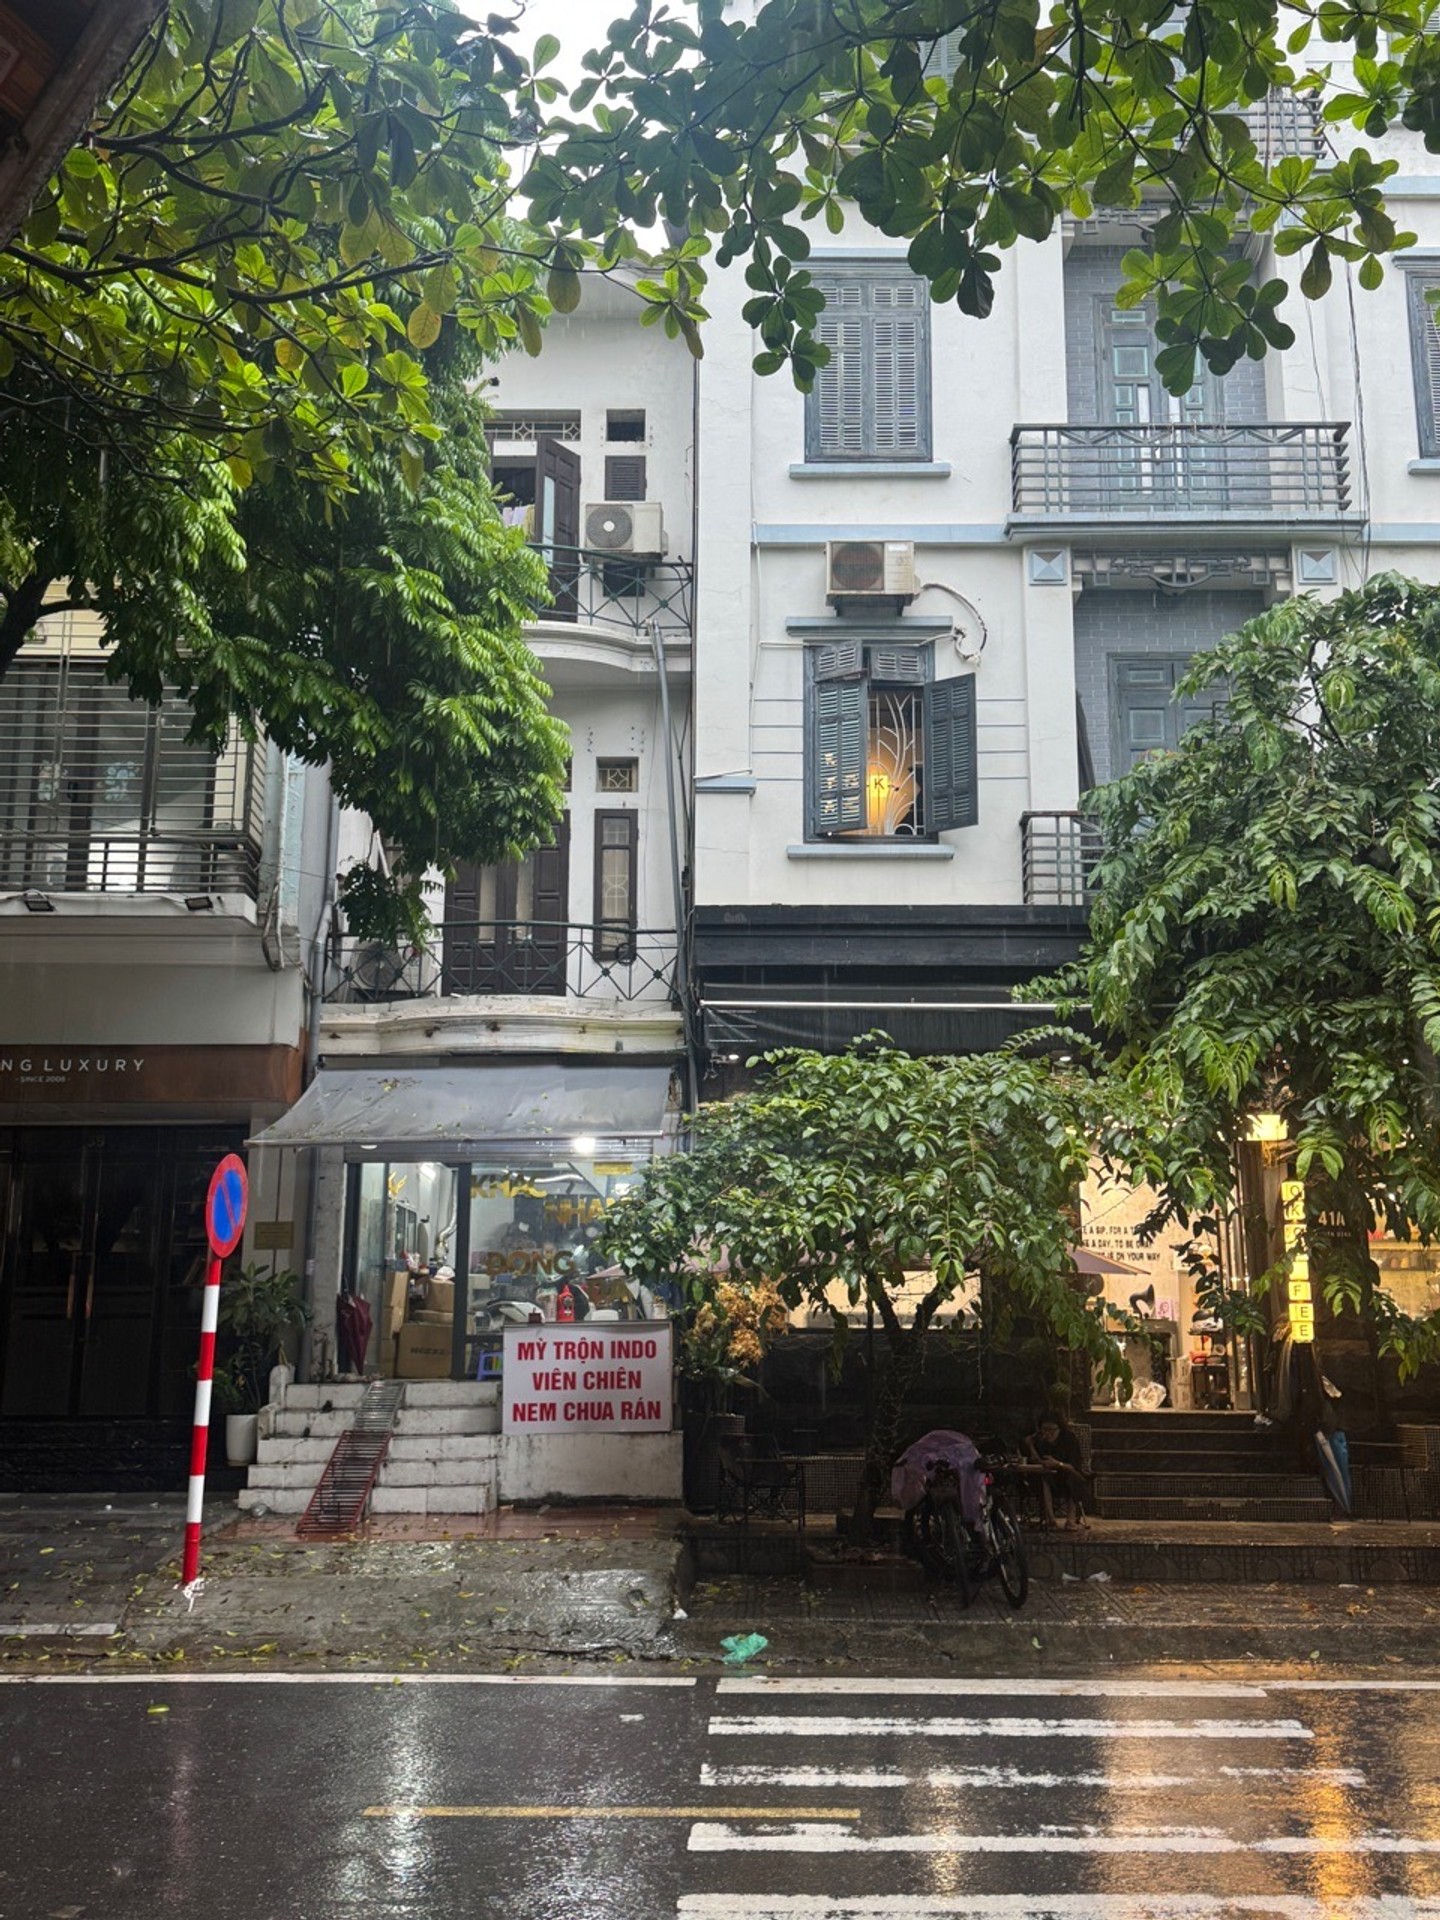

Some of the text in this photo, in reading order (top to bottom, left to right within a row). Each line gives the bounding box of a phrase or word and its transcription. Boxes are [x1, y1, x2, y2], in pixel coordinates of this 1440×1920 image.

[44, 1059, 144, 1071] LUXURY
[20, 1075, 44, 1083] SINCE
[1318, 1210, 1346, 1227] 41A
[1116, 1252, 1125, 1260] ON
[1127, 1252, 1145, 1260] YOUR
[1146, 1252, 1160, 1260] WAY
[554, 1337, 604, 1364] TRỘN
[610, 1340, 657, 1359] INDO
[532, 1366, 642, 1390] VIÊN CHIÊN
[512, 1397, 661, 1422] NEM CHUA RÁN
